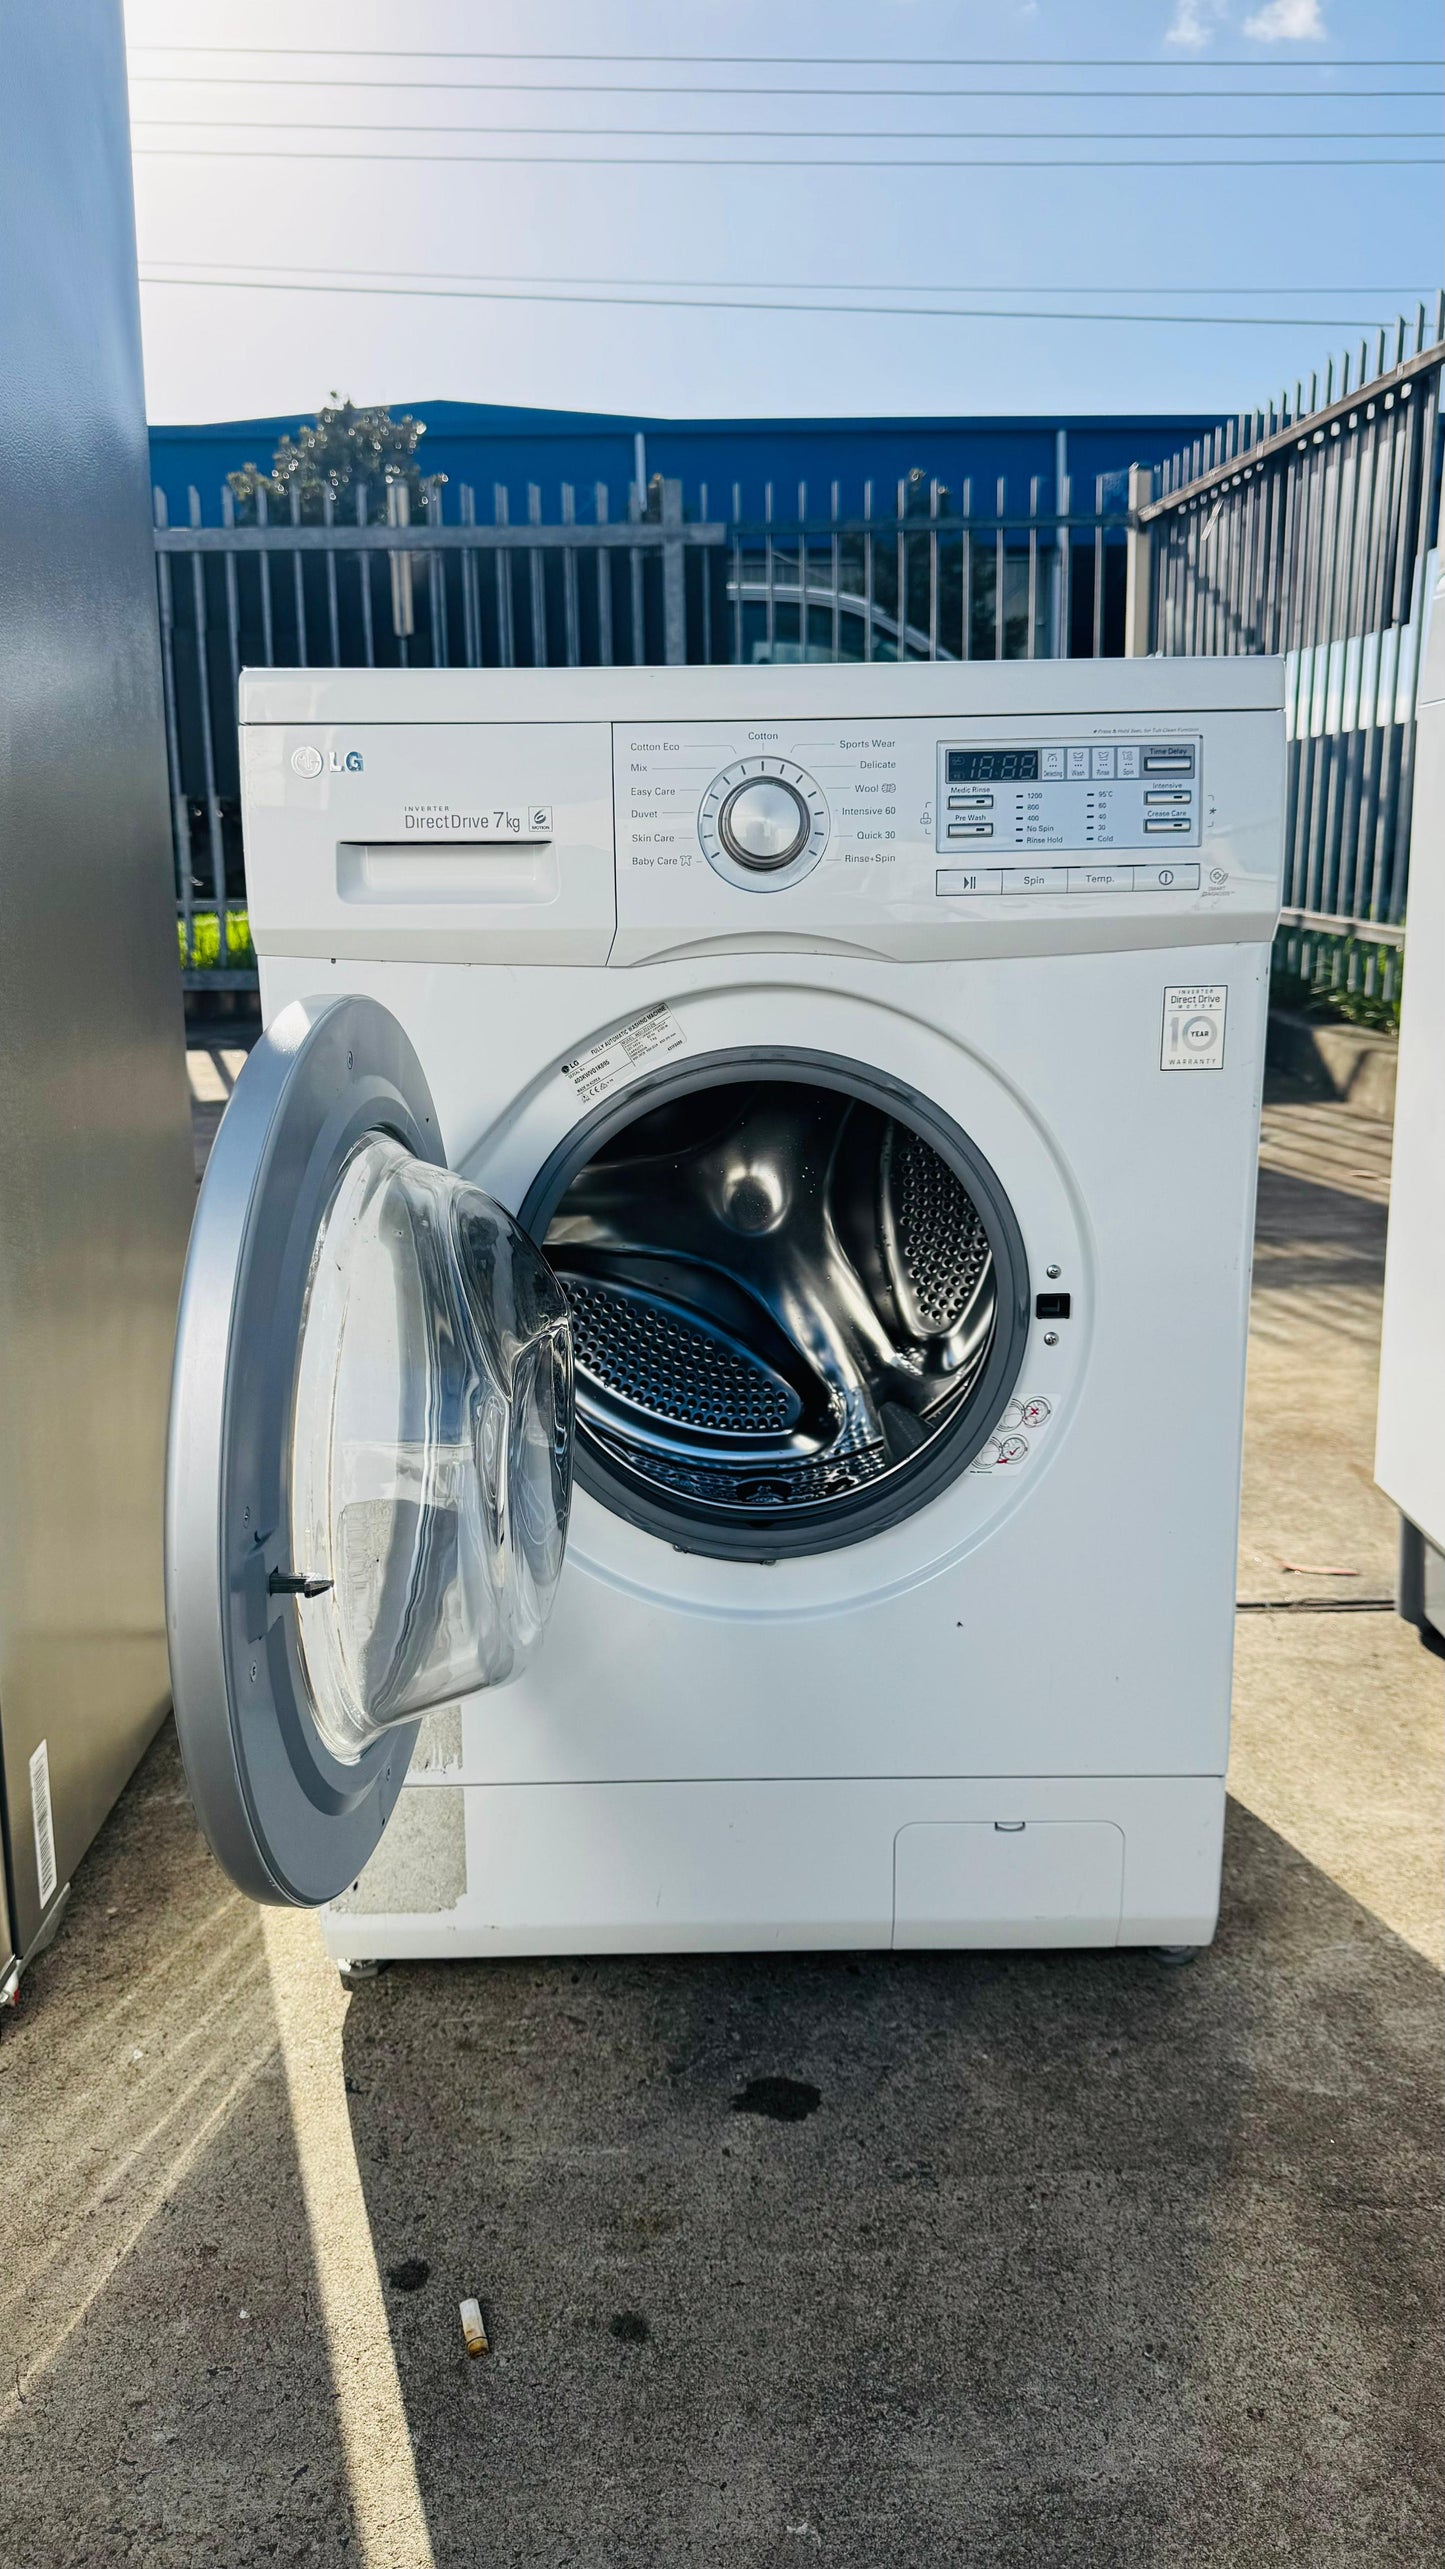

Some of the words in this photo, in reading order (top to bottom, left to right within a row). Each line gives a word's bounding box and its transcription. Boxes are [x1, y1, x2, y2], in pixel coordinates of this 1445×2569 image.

[748, 732, 778, 740] Cotton
[630, 743, 661, 751] Cotton
[663, 743, 680, 751] Eco
[839, 740, 869, 749] Sports
[871, 739, 896, 747] Wear
[329, 751, 364, 772] LG
[860, 760, 896, 769] Delicate
[631, 764, 647, 772] Mix
[631, 787, 653, 797] Easy
[655, 787, 676, 795] Care
[855, 784, 879, 793] Wool
[631, 810, 658, 818] Duvet
[842, 807, 883, 815] Intensive
[885, 806, 896, 815] 60
[955, 814, 967, 822] Pre
[632, 834, 653, 842] Skin
[655, 834, 674, 842] Care
[857, 831, 882, 840] Quick
[884, 831, 896, 840] 30
[632, 857, 655, 866] Baby
[656, 857, 678, 865] Care
[845, 854, 896, 863] Rinse+Spin
[1023, 875, 1045, 886] Spin
[1085, 874, 1115, 884] Temp.
[1171, 996, 1196, 1004] Direct
[1198, 995, 1220, 1003] Drive
[1170, 1016, 1217, 1052] 10
[591, 1043, 605, 1054] FULLY
[605, 1030, 628, 1048] AUTOMATIC
[569, 1060, 580, 1069] LG
